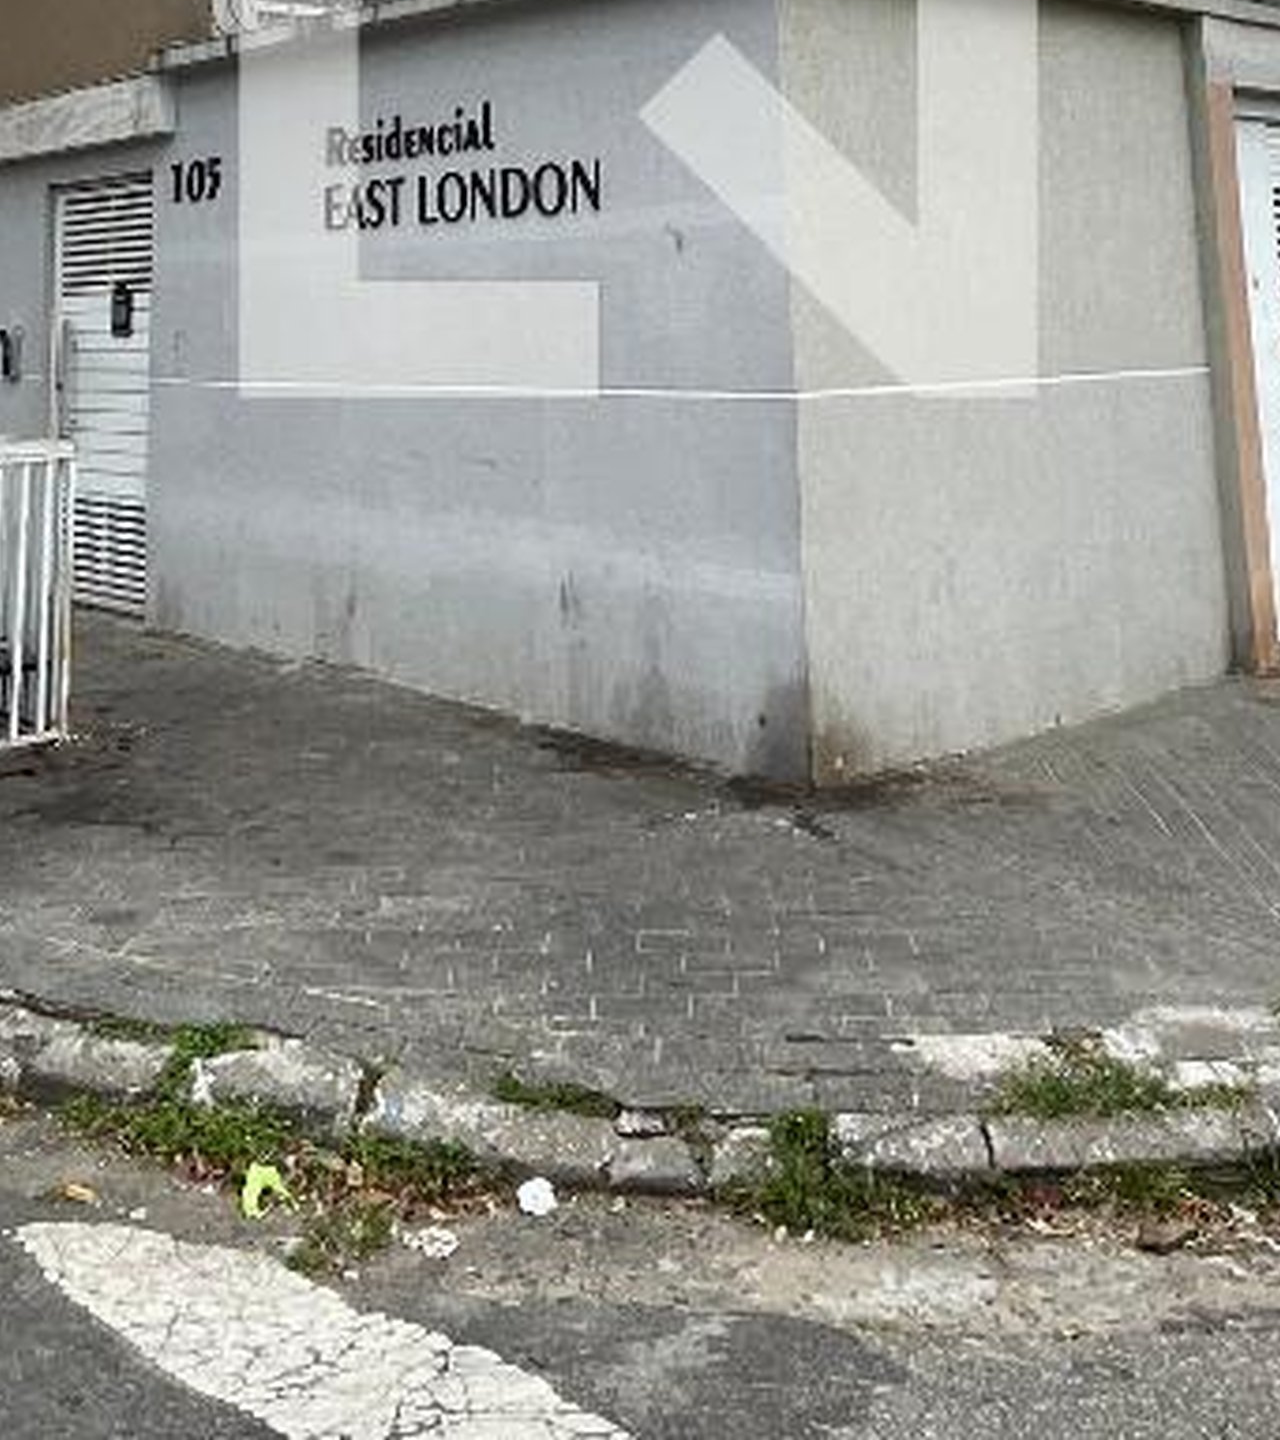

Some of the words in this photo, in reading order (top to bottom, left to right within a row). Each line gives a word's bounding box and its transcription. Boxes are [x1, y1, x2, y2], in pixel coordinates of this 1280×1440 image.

[327, 100, 495, 166] Residencial
[171, 157, 221, 203] 105
[324, 177, 405, 230] EAST
[418, 159, 602, 224] LONDON
